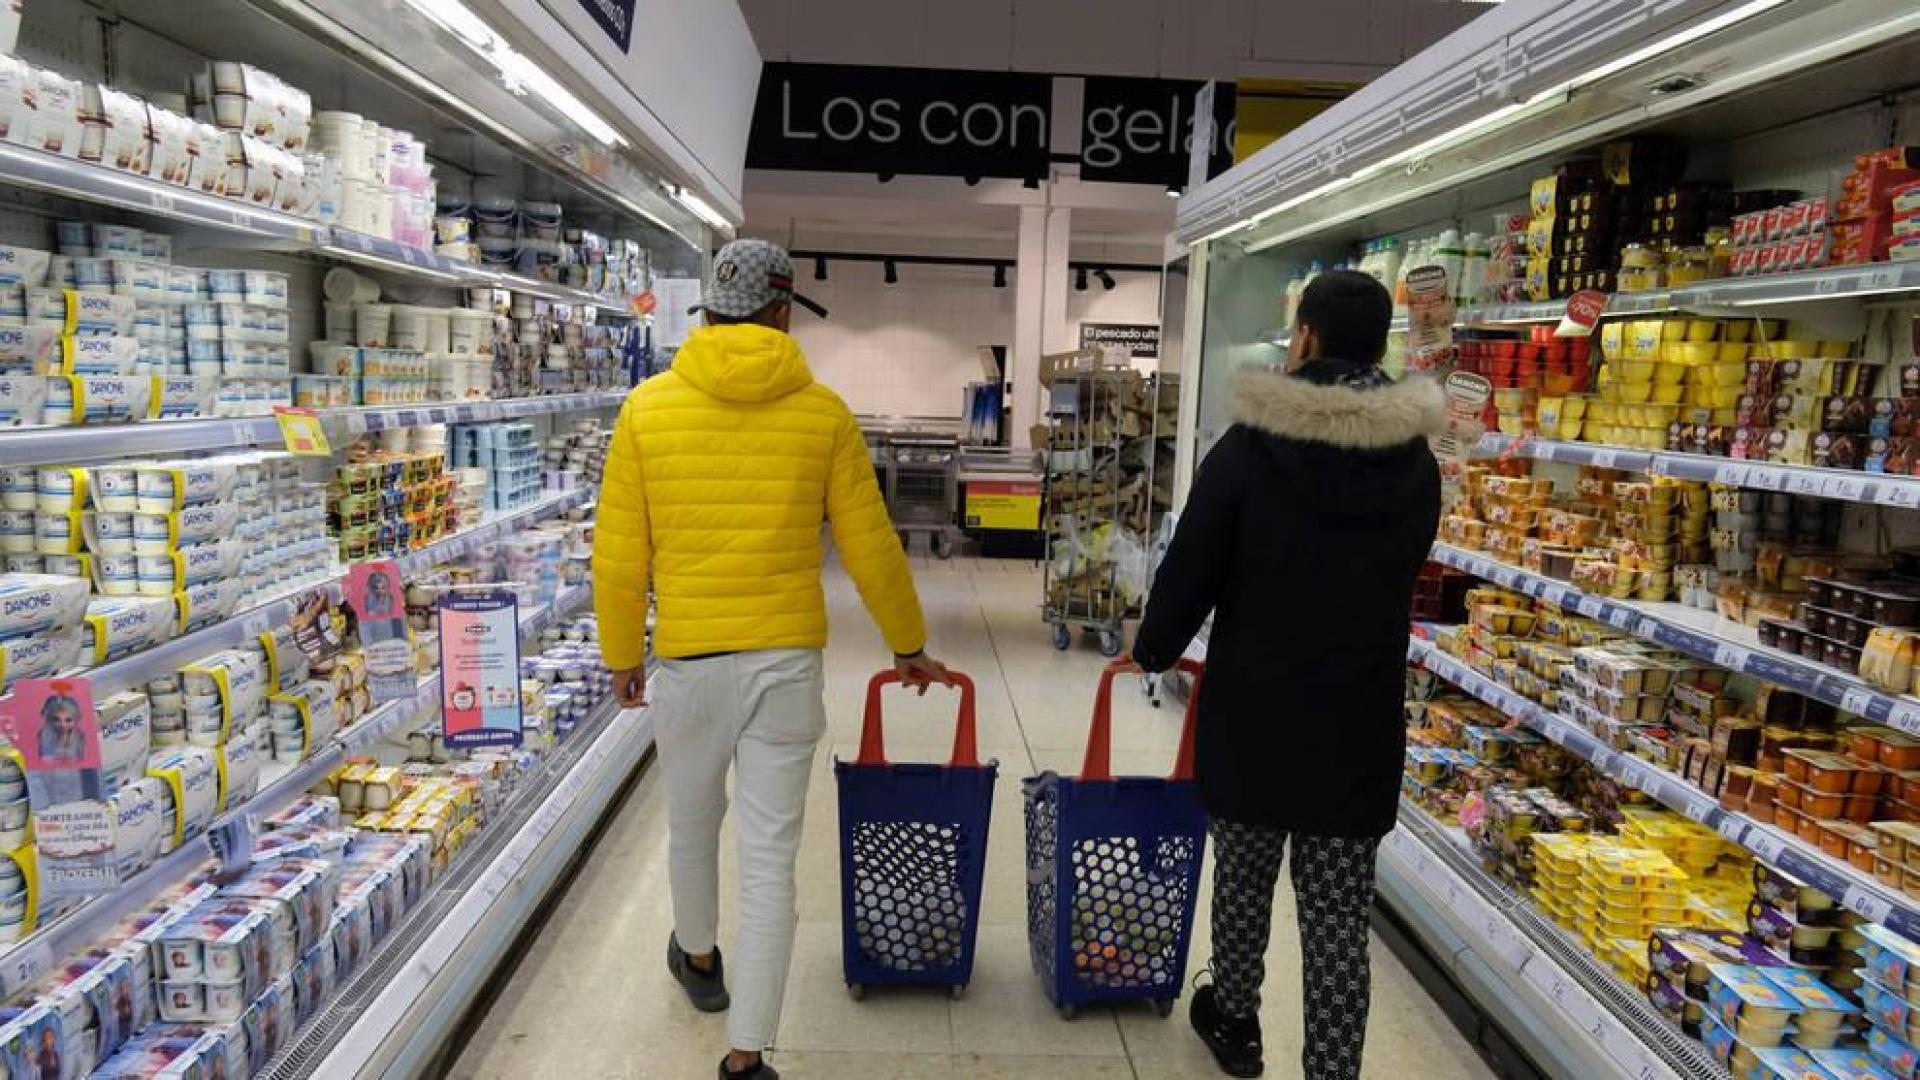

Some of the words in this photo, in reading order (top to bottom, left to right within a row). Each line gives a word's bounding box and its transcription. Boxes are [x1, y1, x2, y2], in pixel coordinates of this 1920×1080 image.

[782, 80, 901, 143] Los
[920, 100, 1046, 148] con
[80, 298, 111, 311] DANONE
[1096, 327, 1140, 340] pescado
[79, 340, 112, 353] DANONE
[90, 381, 125, 395] DANONE
[165, 381, 195, 393] DANONE
[5, 592, 51, 615] DANONE
[112, 611, 147, 631] DANONE
[103, 713, 145, 739] DANONE
[118, 799, 155, 825] DANONE
